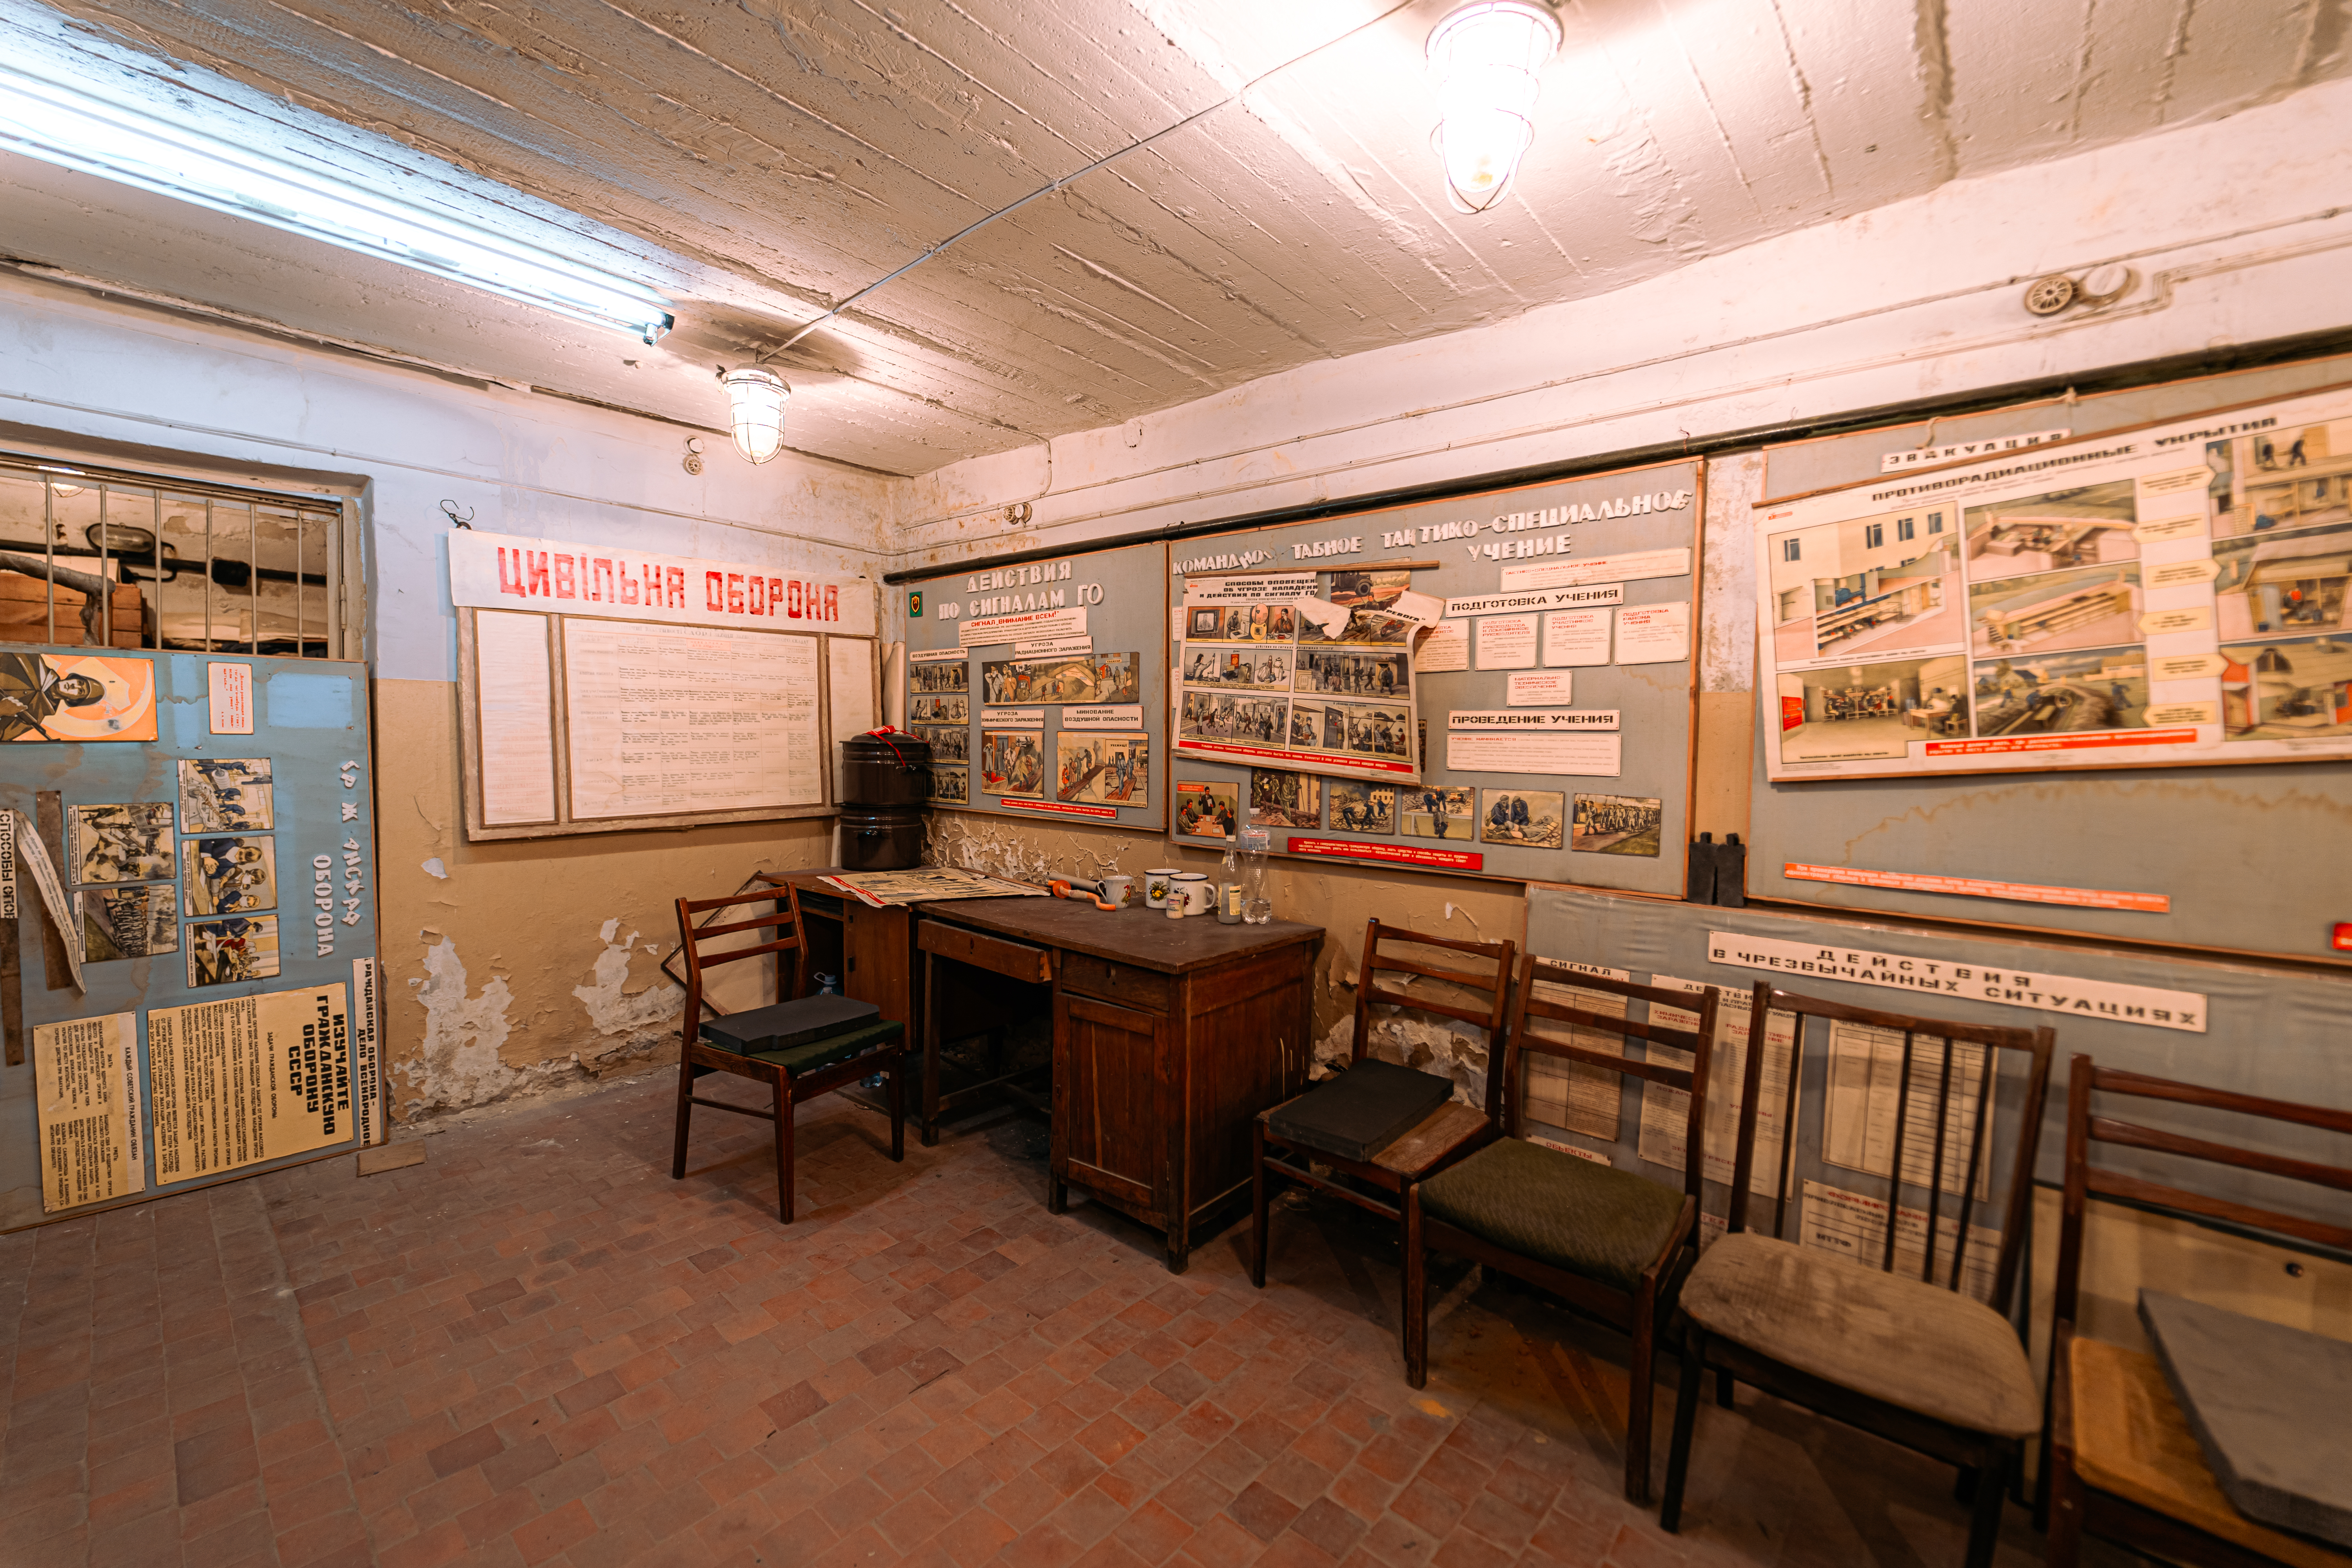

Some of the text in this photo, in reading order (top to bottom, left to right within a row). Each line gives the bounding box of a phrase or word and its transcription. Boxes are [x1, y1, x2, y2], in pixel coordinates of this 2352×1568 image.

[1292, 536, 1363, 559] ТАБНОЕ
[1468, 534, 1570, 561] УЧЕНИЕ
[497, 547, 838, 621] ЦИВІЛЬНА ОБОРОНА
[966, 561, 1072, 593] ДЕЙСТВИЯ
[1505, 563, 1580, 575] ТАКТИКО-СПЕЦИАЛЬНОЕ
[938, 583, 1104, 620] ПО СИГНАЛАМ ГО
[1452, 589, 1618, 612] ПОДГОТОВКА УЧЕНИЯ
[1623, 608, 1669, 617] ПОДГОТОВКА
[1452, 715, 1613, 724] ПРОВЕДЕНИЕ УЧЕНИЯ
[0, 814, 13, 881] СПОСОБЫ
[313, 855, 334, 958] ОБОРОНА
[1550, 960, 1611, 976] СИГНАЛ
[1817, 949, 2031, 987] ДЕЙСТВИЯ
[1713, 949, 1725, 958] В
[1738, 952, 1959, 992] ЧРЕЗВЫЧАЙНЫХ
[1985, 986, 2196, 1025] СИТУАЦИЯХ
[124, 1046, 132, 1071] КАЖДЫЙ
[268, 1053, 276, 1091] ГРАЖДАНСКОЙ
[288, 1045, 302, 1098] СССР
[303, 1023, 319, 1113] ОБОРОНУ
[316, 995, 335, 1136] ГРАЖДАНСКУЮ
[333, 1013, 351, 1111] ИЗУЧАЙТЕ
[126, 1072, 134, 1103] СОВЕТСКИЙ
[357, 1028, 370, 1147] ДЕЛО ВСЕНАРОДНОЕ
[128, 1104, 136, 1138] ГРАЖДАНИН
